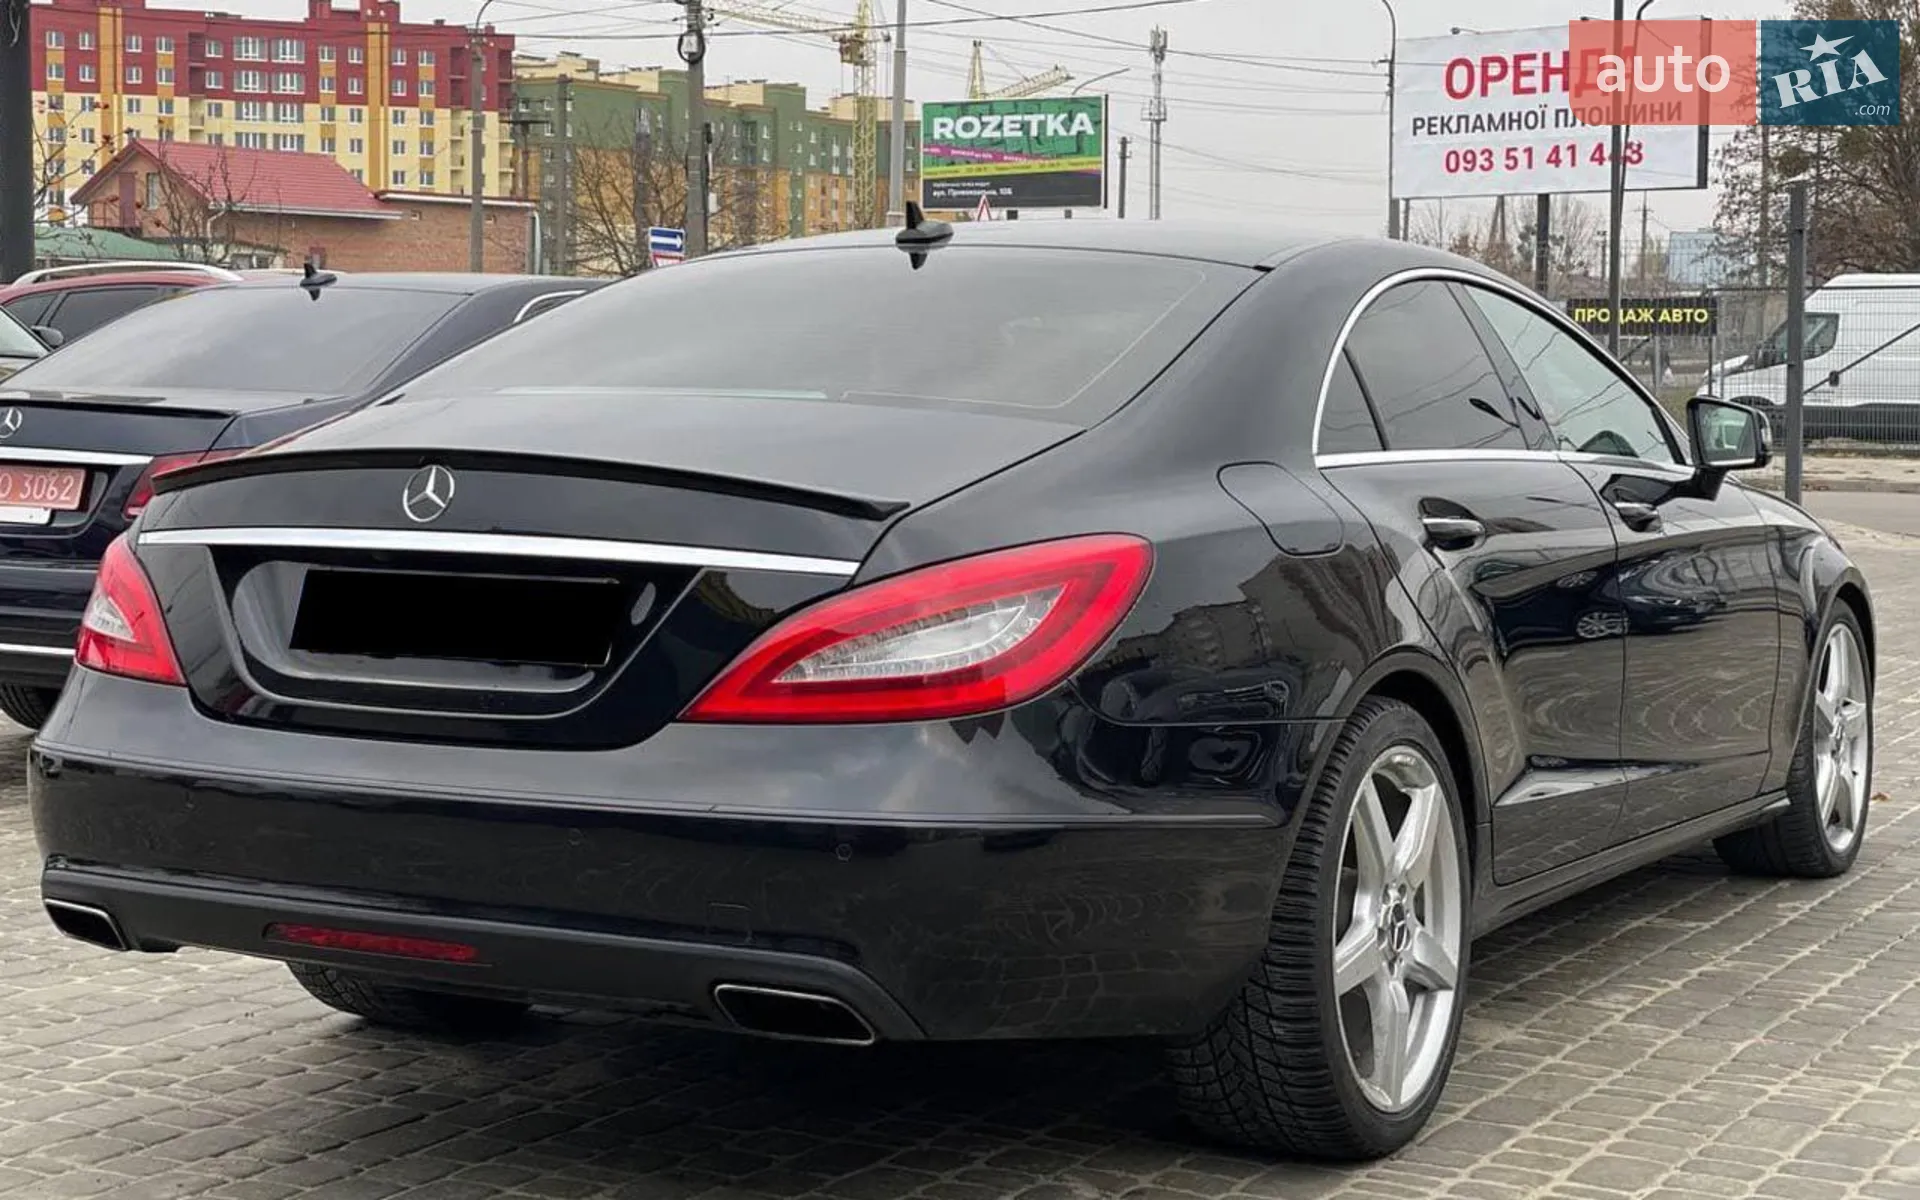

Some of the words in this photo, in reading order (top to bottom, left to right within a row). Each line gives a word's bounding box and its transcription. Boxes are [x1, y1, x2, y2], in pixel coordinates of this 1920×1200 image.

[933, 112, 1095, 140] ROZETKA
[1412, 104, 1546, 136] РЕКЛАМНОЇ
[1445, 148, 1494, 173] 093
[1504, 146, 1533, 171] 51
[1546, 144, 1577, 168] 41
[1589, 141, 1643, 166] 43
[1574, 308, 1655, 325] ПРОАЖ
[1658, 308, 1708, 323] АВТО
[20, 473, 73, 500] 3062
